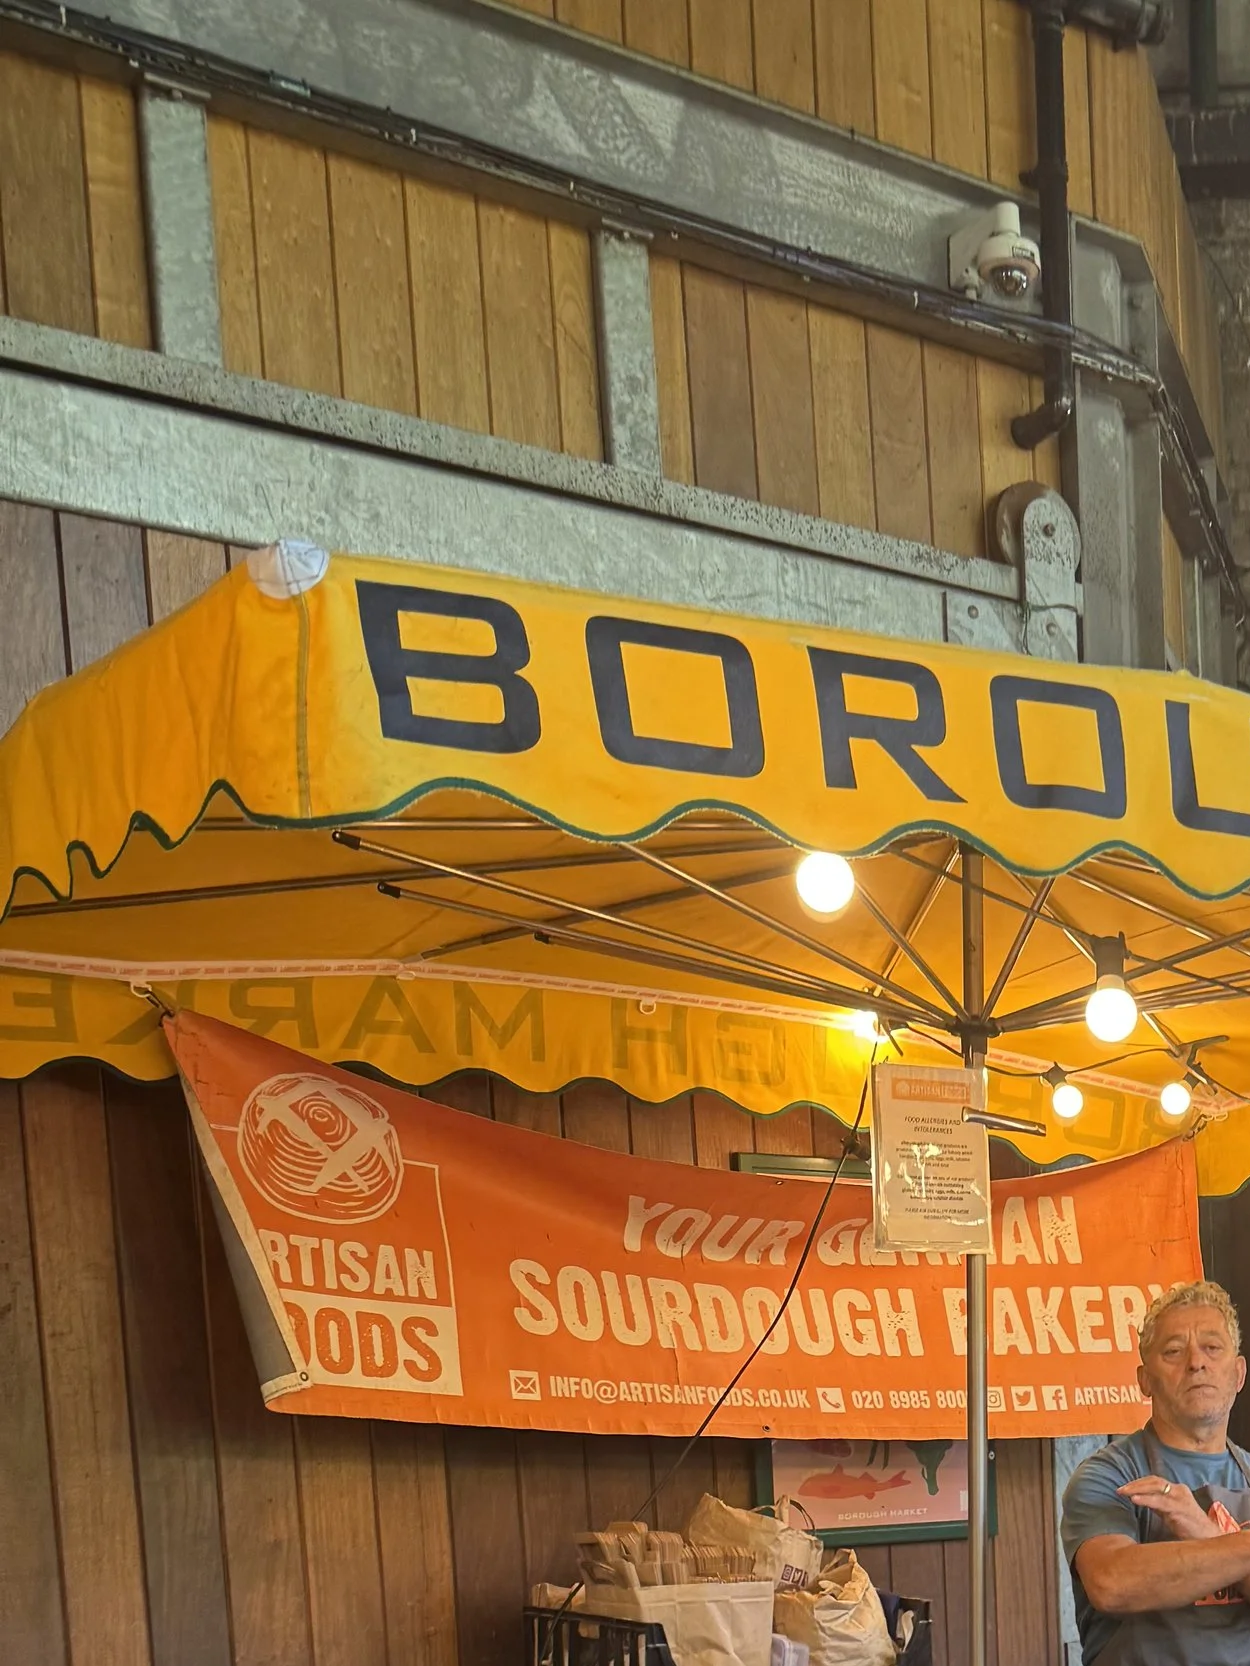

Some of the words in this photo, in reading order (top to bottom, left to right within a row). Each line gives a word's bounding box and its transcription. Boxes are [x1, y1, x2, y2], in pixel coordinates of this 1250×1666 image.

[622, 1194, 805, 1267] YOUR
[817, 1196, 1083, 1268] GEAN
[258, 1228, 438, 1300] RTISAN
[510, 1260, 925, 1357] SOURDOUGH
[942, 1282, 1185, 1357] BAKER
[549, 1375, 811, 1409] INFO@ARTISANFOODS.CO.UK
[851, 1389, 884, 1409] 020
[889, 1389, 930, 1409] 8985
[936, 1389, 967, 1409] 800
[838, 1511, 887, 1521] BOROUGH
[890, 1508, 928, 1517] MARKET
